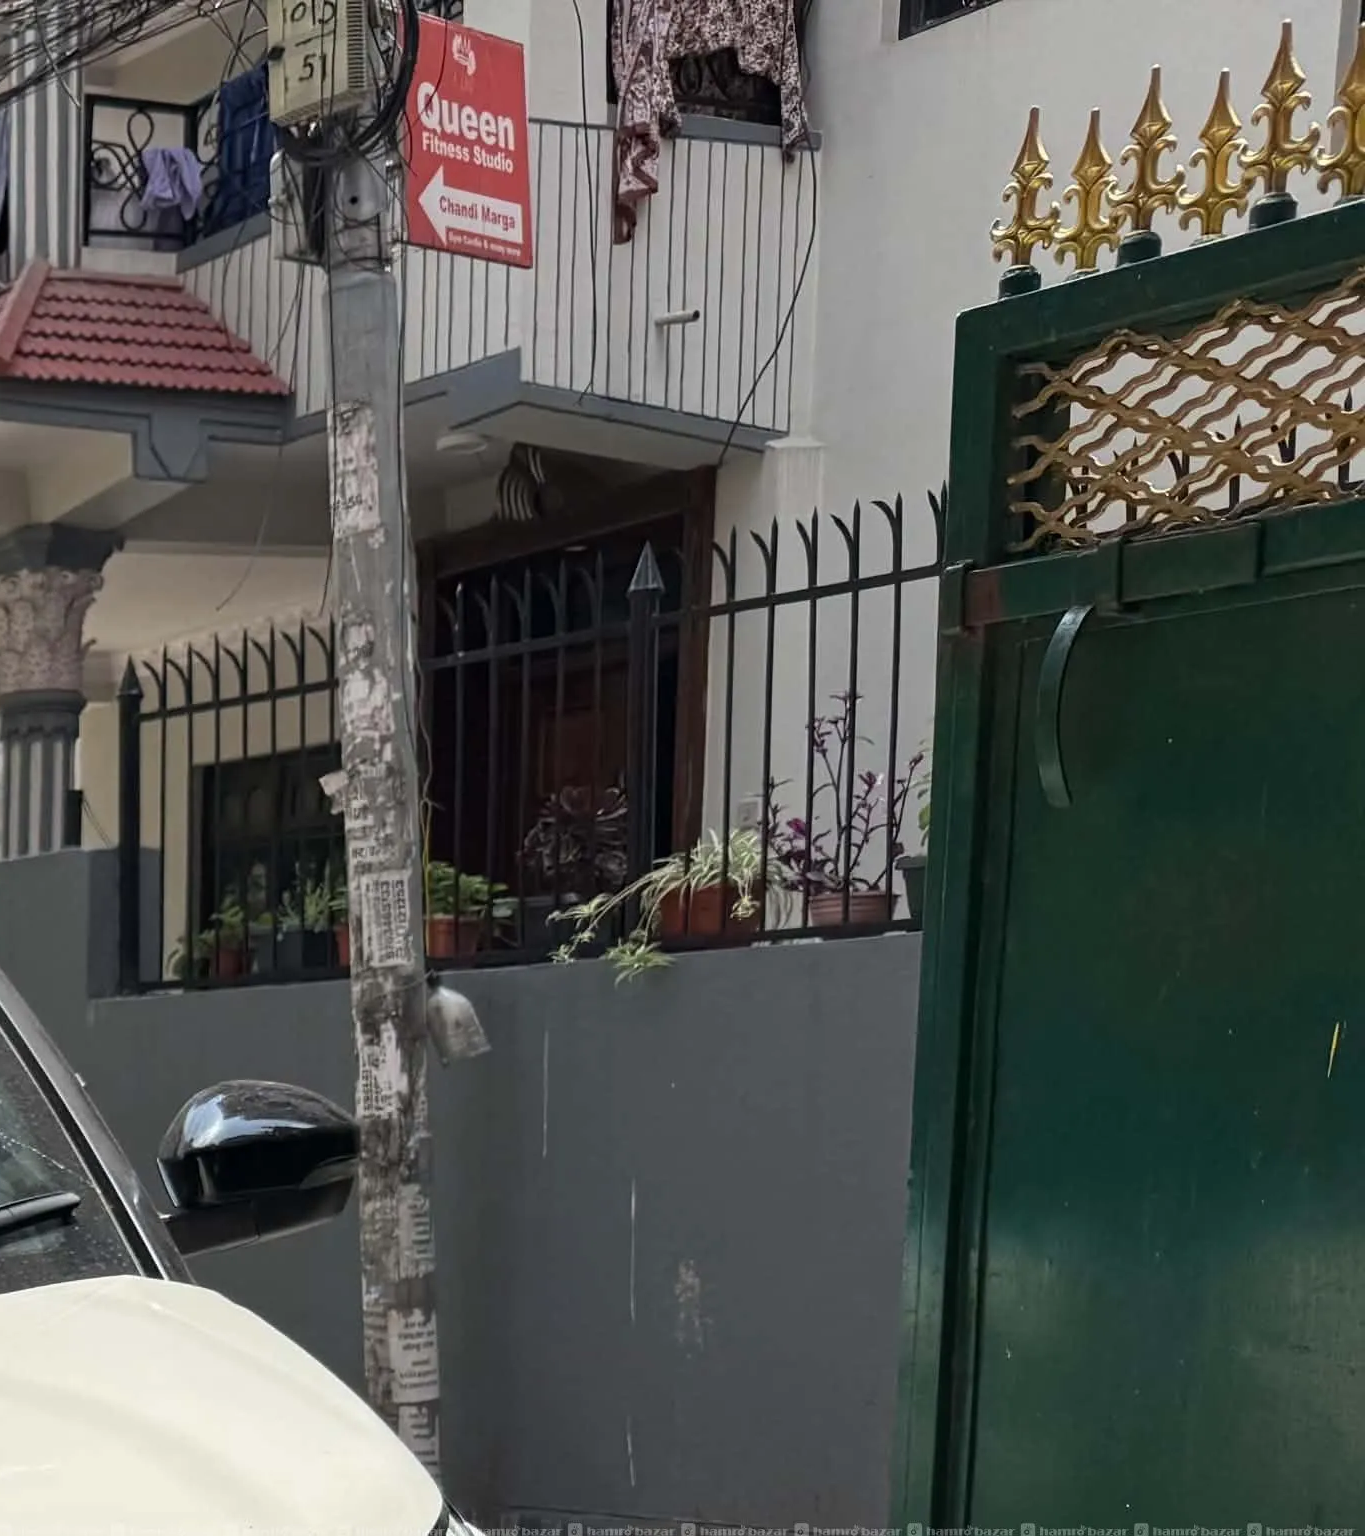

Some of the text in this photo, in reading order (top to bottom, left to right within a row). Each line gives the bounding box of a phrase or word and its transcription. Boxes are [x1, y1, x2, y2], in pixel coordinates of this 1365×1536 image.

[417, 81, 515, 152] Queen
[422, 131, 514, 174] Fitness Studio
[439, 195, 516, 231] Chandi Marga
